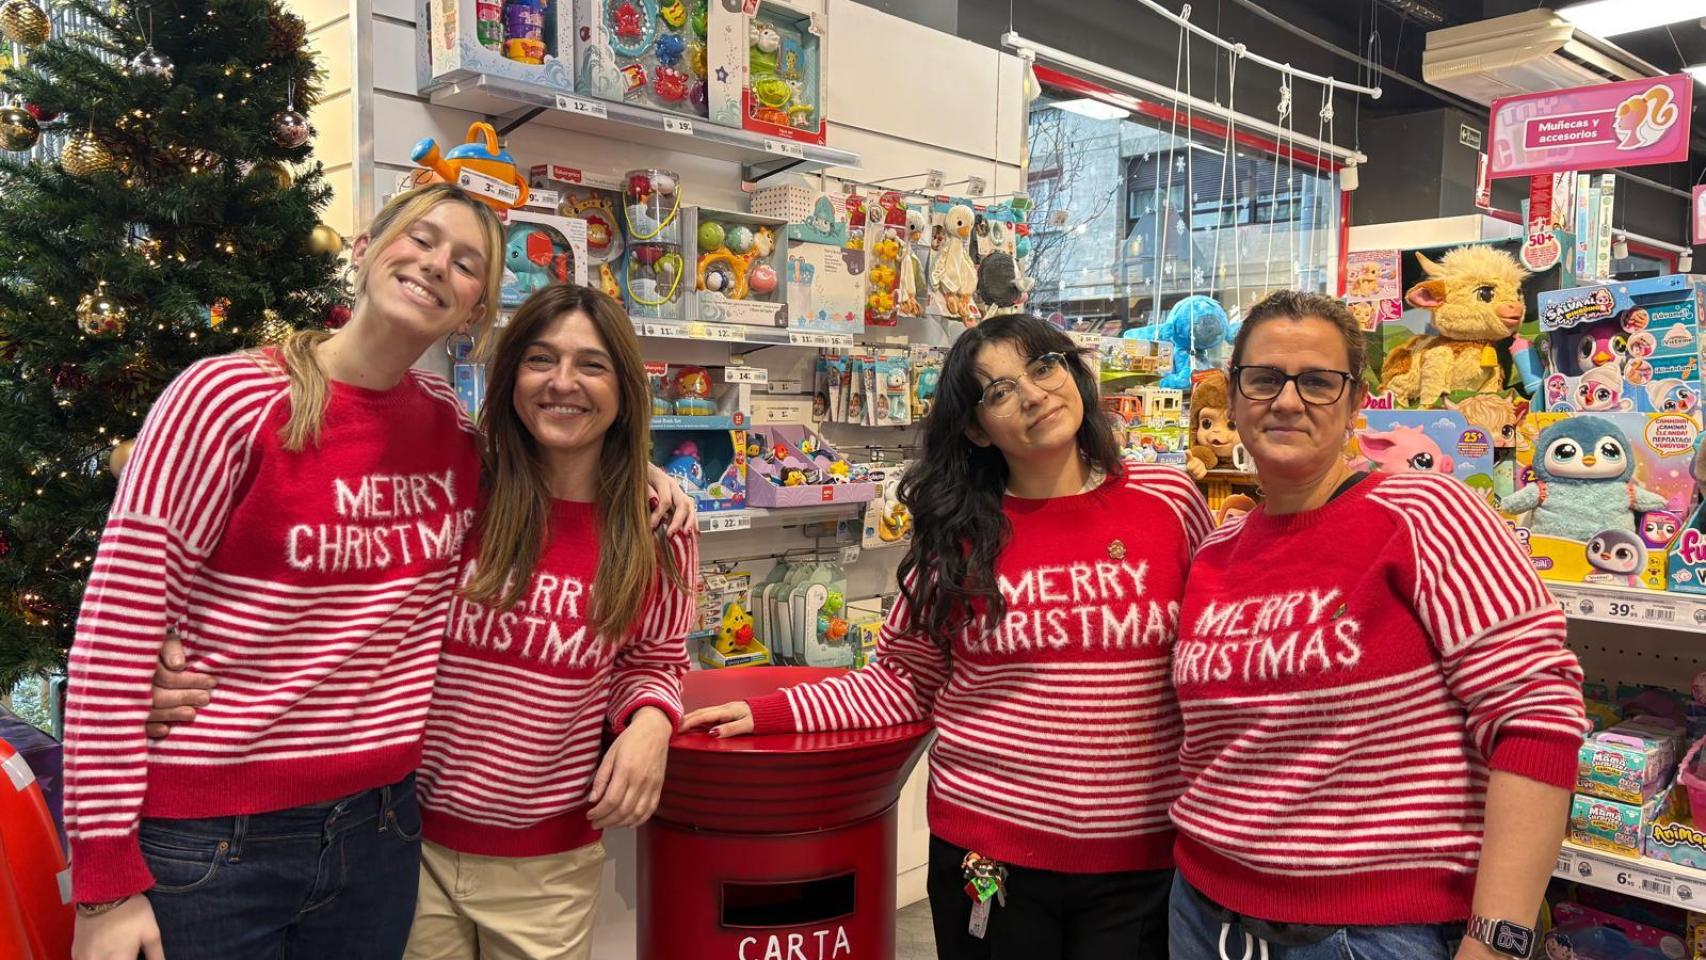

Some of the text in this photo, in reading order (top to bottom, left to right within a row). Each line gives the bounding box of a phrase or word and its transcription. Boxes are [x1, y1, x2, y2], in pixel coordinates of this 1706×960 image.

[1538, 119, 1600, 132] Muñecas y
[1538, 130, 1598, 143] accesorios
[1529, 233, 1555, 246] 50+
[334, 469, 457, 519] MERRY
[998, 560, 1149, 606] MERRY
[1194, 588, 1343, 638] MERRY
[738, 926, 851, 960] CARTA
